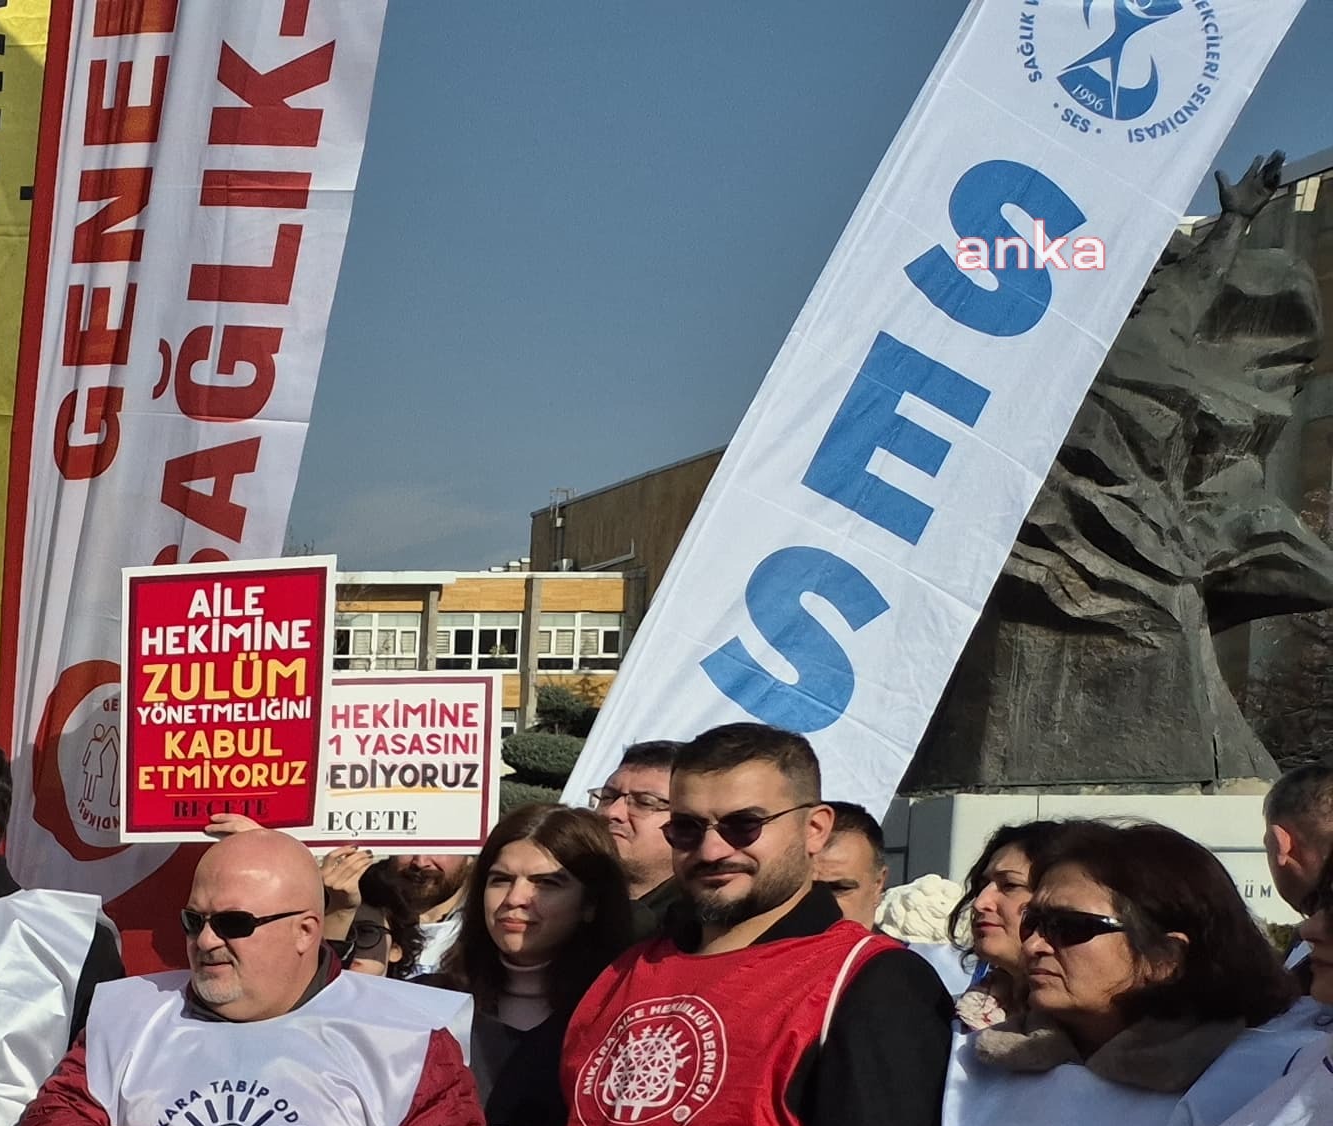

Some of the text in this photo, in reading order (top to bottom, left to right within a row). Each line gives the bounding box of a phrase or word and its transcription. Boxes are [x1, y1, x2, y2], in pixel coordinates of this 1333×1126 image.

[1017, 12, 1042, 83] SAĞLIK
[1128, 0, 1224, 143] EKÇİLERİ SENDİKASI
[1071, 84, 1104, 111] 1996
[1061, 108, 1091, 133] SES
[700, 159, 1088, 735] SES
[187, 583, 265, 619] AİLE
[141, 619, 312, 656] HEKİMİNE
[142, 652, 307, 702] ZULÜM
[137, 696, 312, 726] YÖNETMELİĞİNİ
[331, 698, 479, 729] HEKİMİNE
[164, 727, 282, 760] KABUL
[355, 733, 478, 756] YASASINI
[138, 760, 307, 791] ETMİYORUZ
[326, 759, 479, 789] EDİYORUZ
[323, 810, 417, 837] EÇETE
[583, 1036, 616, 1095] ANKARA
[691, 1030, 717, 1103] DERNEĞİ
[210, 1079, 270, 1099] TABİP
